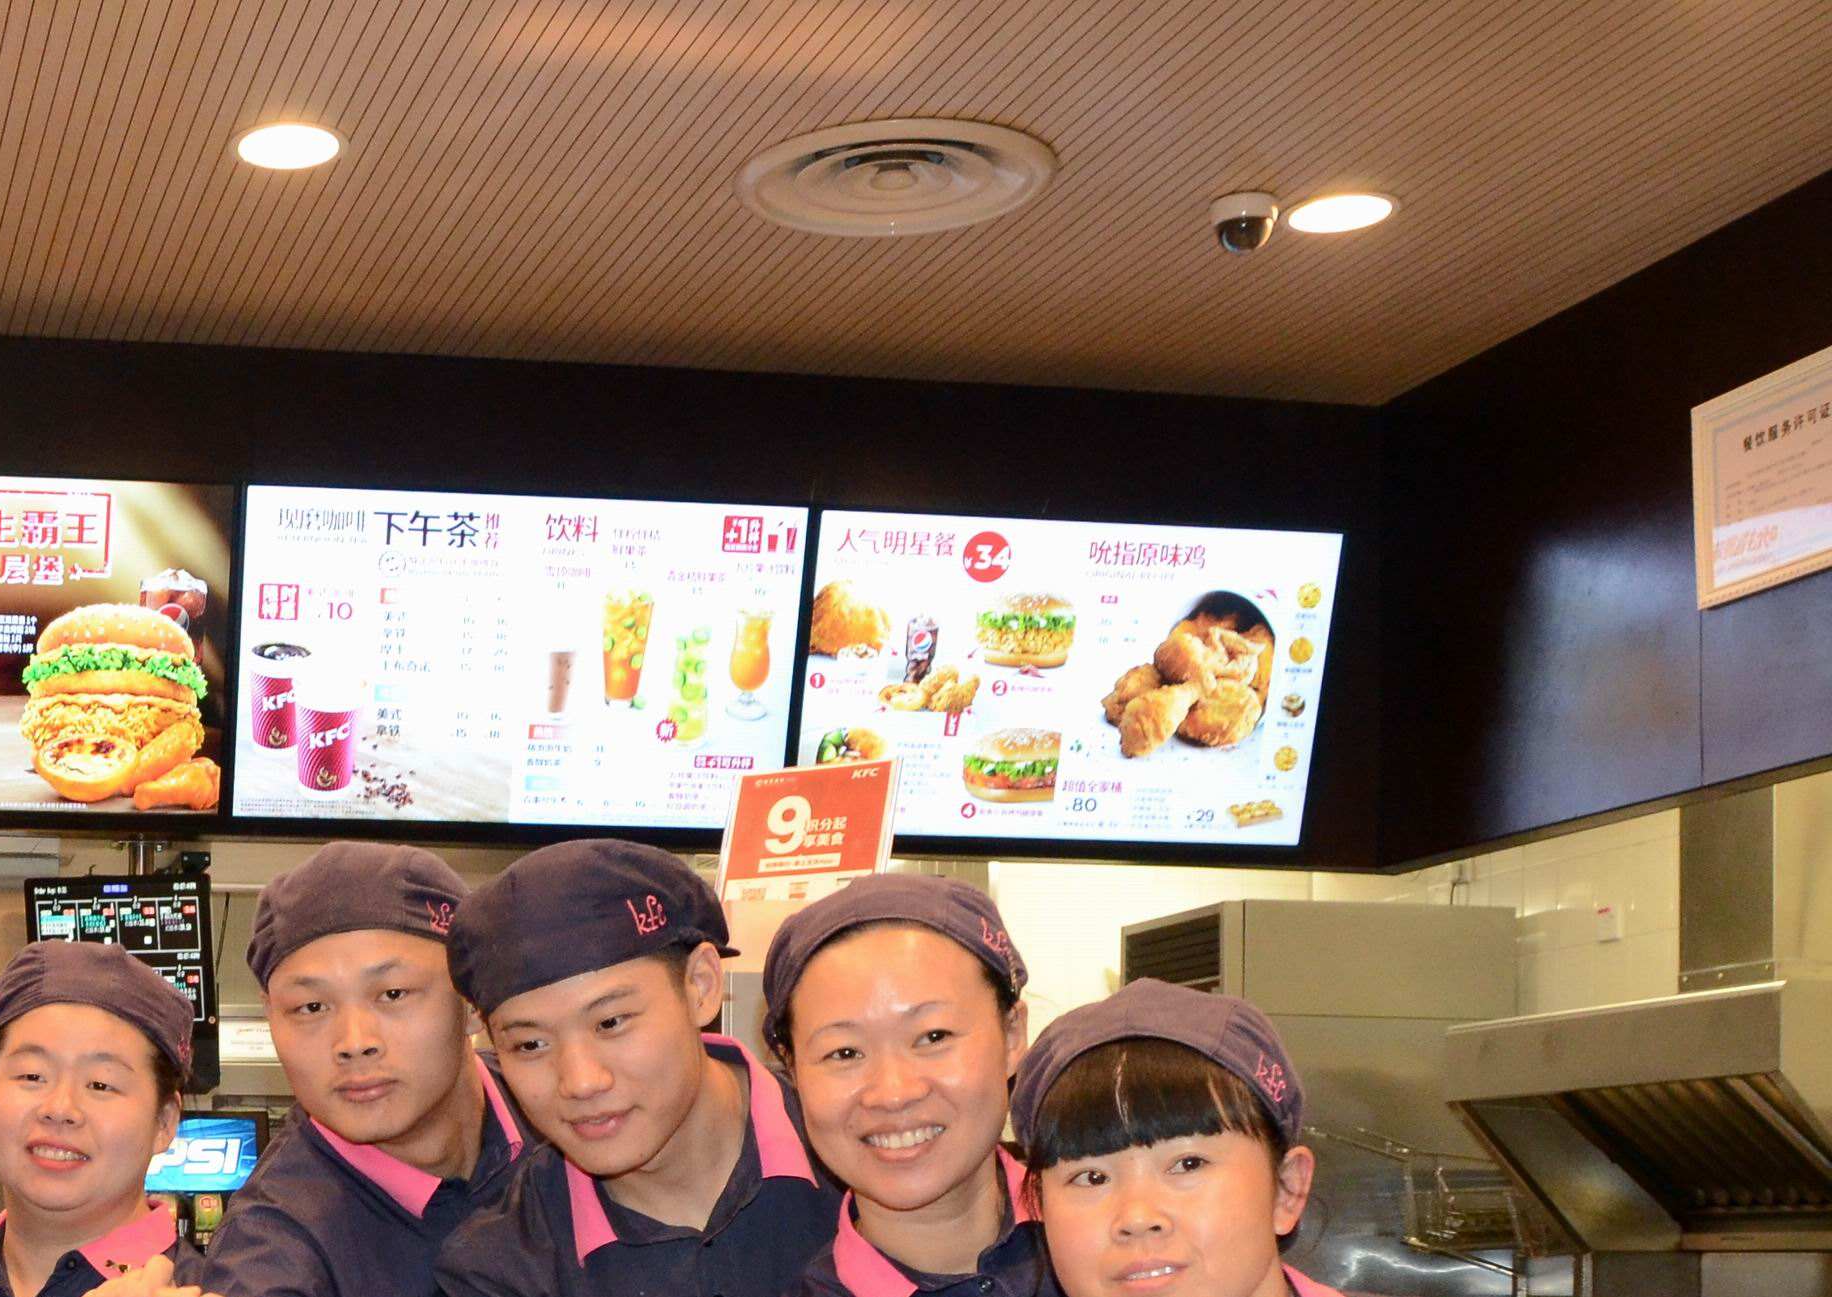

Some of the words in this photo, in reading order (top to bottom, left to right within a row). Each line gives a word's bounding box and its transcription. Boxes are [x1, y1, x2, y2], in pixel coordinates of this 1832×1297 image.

[373, 510, 481, 548] 下午茶
[545, 513, 599, 543] 饮料
[836, 528, 956, 557] 人气明星餐
[1088, 540, 1206, 569] 吮指原味鸡
[308, 720, 353, 749] KFC
[852, 767, 880, 780] KFC
[765, 795, 812, 855] 9
[627, 894, 668, 936] kfc
